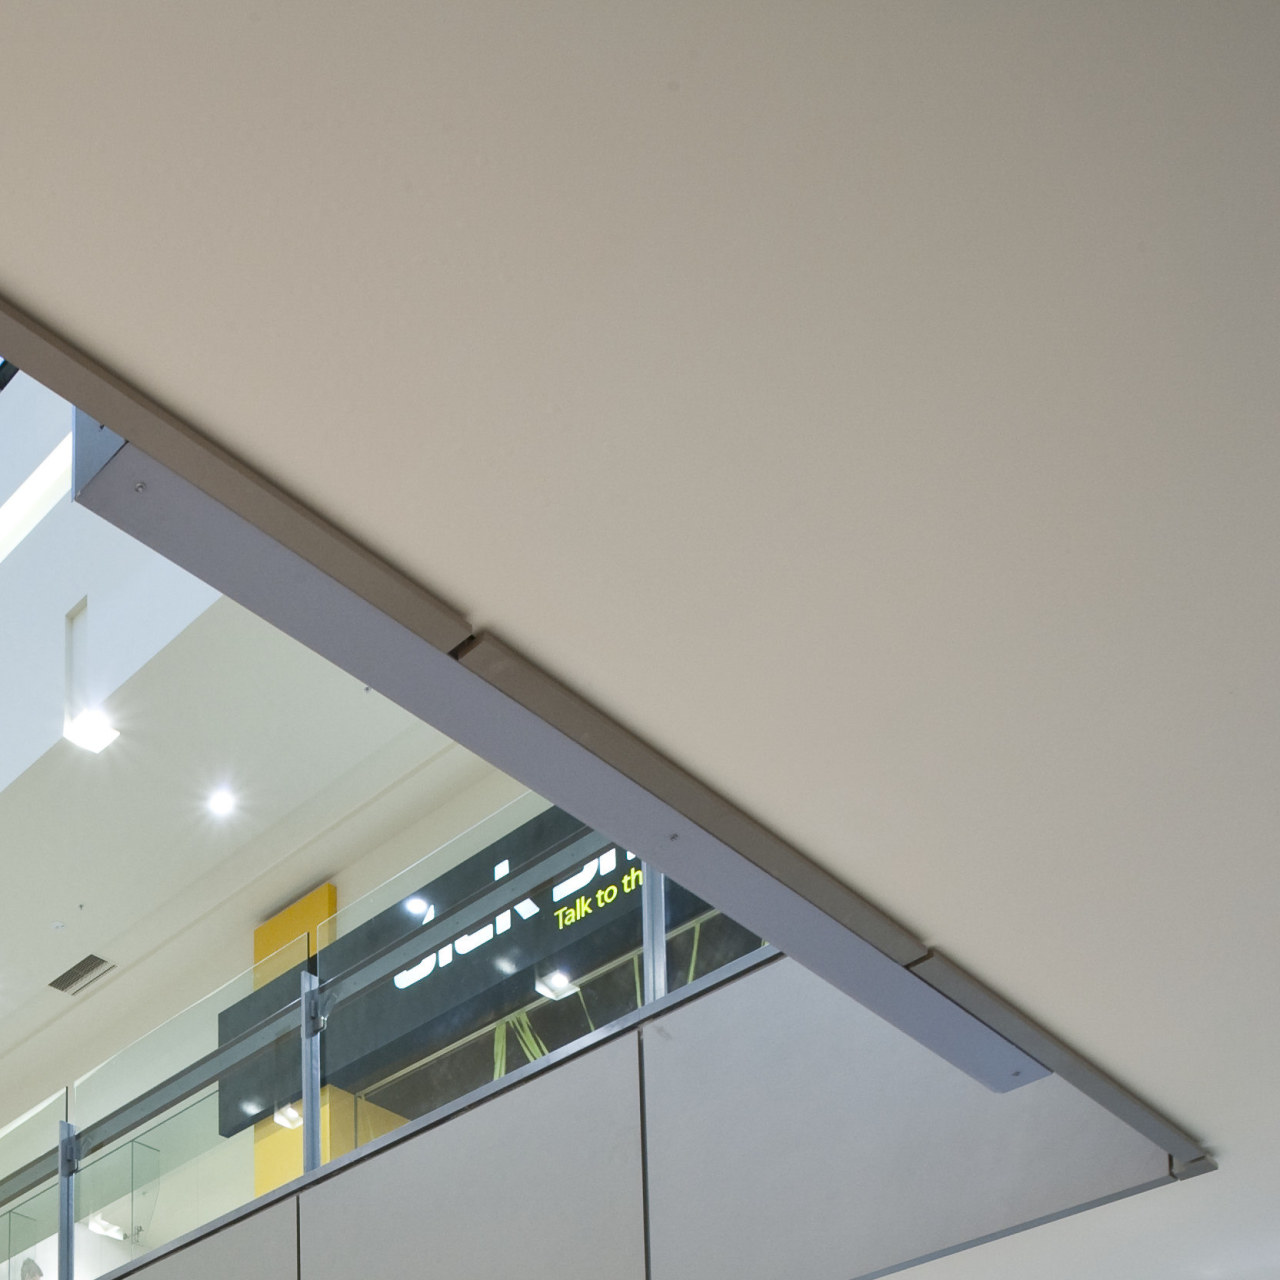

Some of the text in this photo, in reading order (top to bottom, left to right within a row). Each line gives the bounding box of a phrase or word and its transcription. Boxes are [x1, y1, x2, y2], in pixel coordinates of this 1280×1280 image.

[554, 895, 593, 930] Talk
[595, 884, 618, 909] to
[621, 867, 643, 894] th
